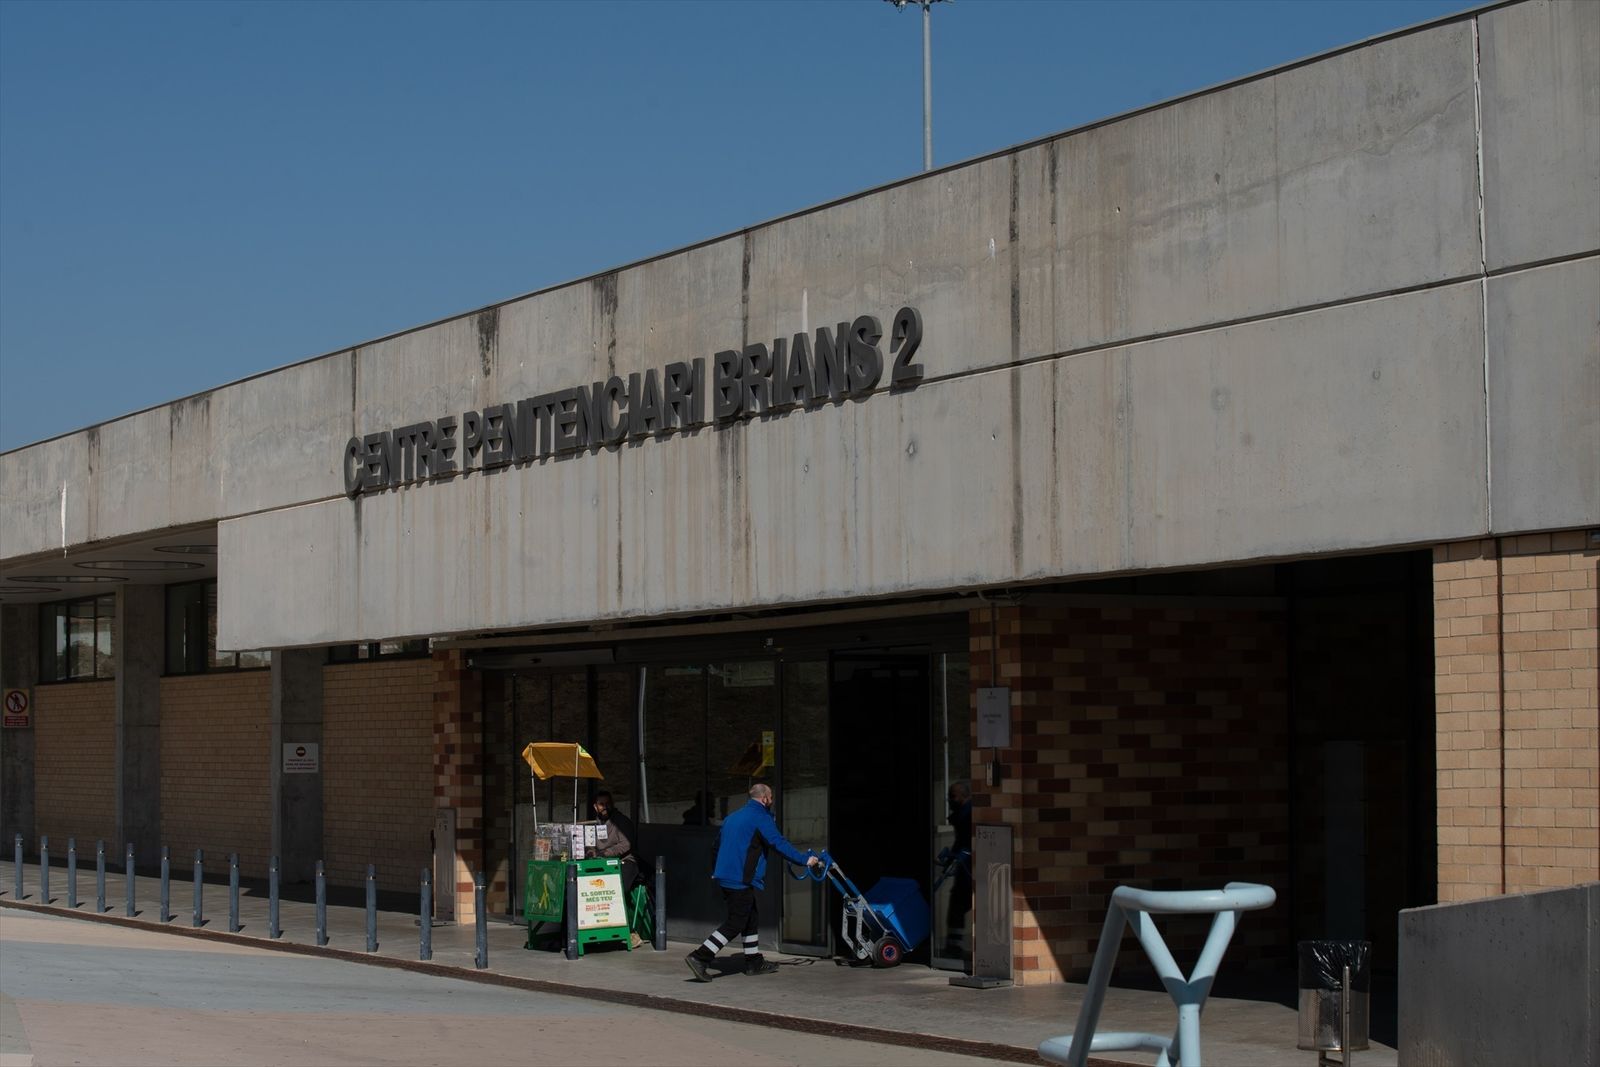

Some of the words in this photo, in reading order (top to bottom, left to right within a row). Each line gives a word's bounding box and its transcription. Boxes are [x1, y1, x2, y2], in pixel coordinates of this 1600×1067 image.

[344, 416, 457, 497] CENTRE
[463, 357, 705, 471] PENITENCIARI
[713, 315, 884, 415] BRIANS
[890, 306, 924, 386] 2
